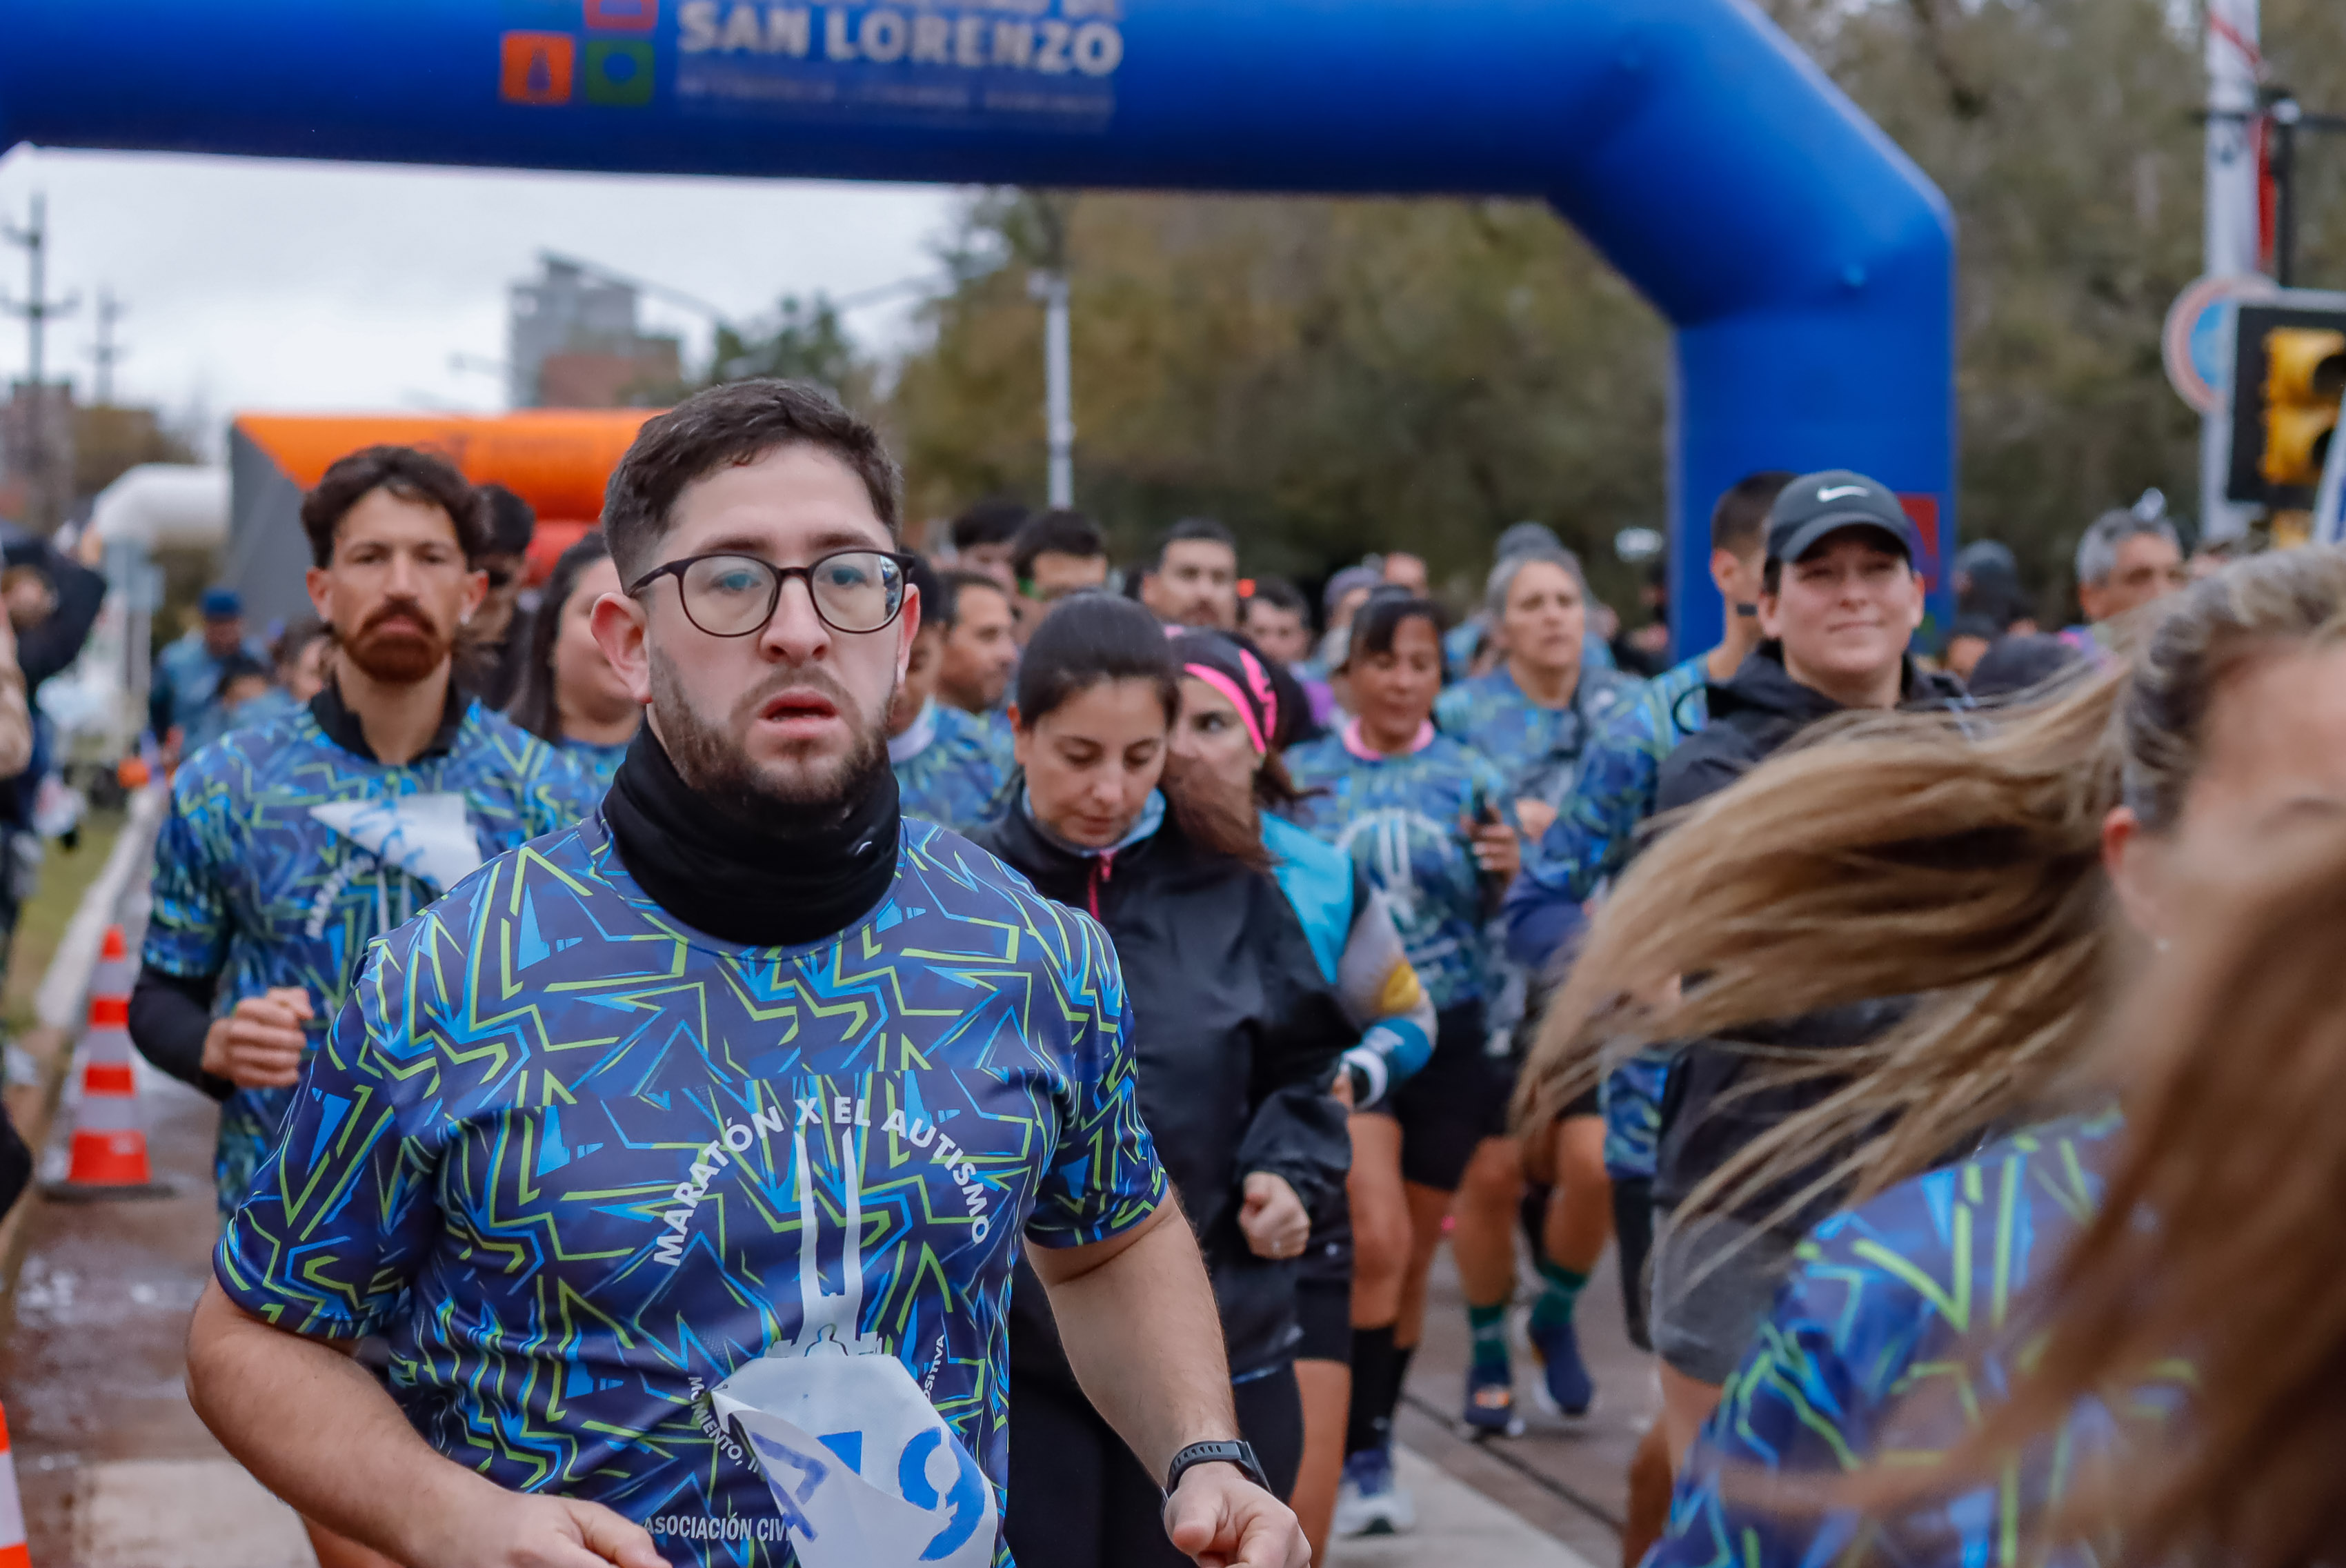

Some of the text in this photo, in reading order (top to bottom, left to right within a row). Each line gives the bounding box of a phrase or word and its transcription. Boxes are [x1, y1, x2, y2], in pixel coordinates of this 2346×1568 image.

[677, 1, 1125, 77] SAN LORENZO
[653, 1096, 990, 1267] MARATÓN X EL AUTISMO
[644, 1512, 752, 1540] ASOCIACIÓN
